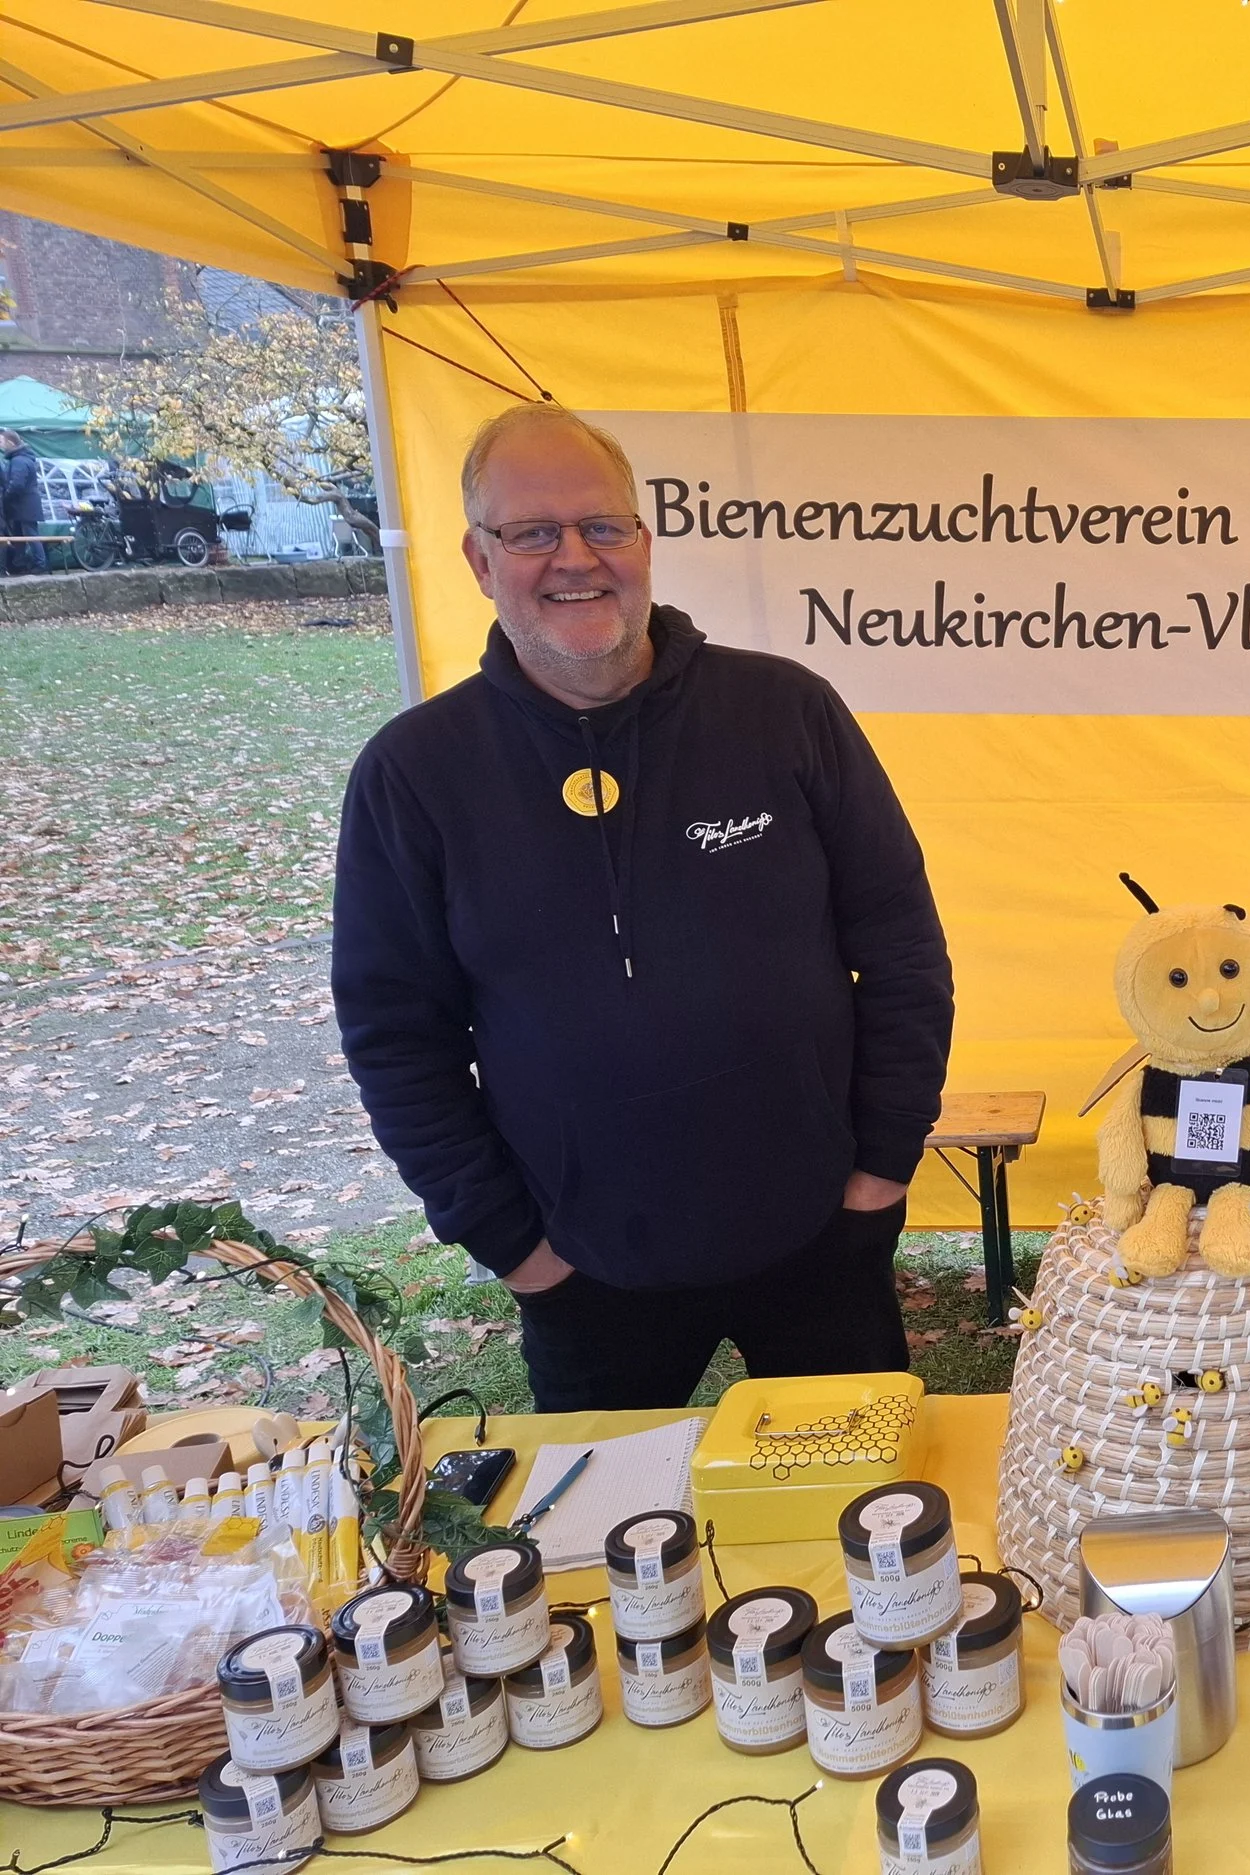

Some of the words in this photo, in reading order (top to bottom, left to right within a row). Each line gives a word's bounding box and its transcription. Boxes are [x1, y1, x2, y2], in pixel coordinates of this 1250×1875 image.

[645, 473, 1239, 547] Bienenzuchtverein
[686, 820, 724, 849] Tilos
[311, 1469, 321, 1509] LINDESA
[7, 1528, 39, 1539] Linde
[742, 1679, 762, 1688] 500g
[851, 1704, 872, 1713] 500g
[1094, 1790, 1134, 1804] Probe
[1096, 1808, 1133, 1820] Glas
